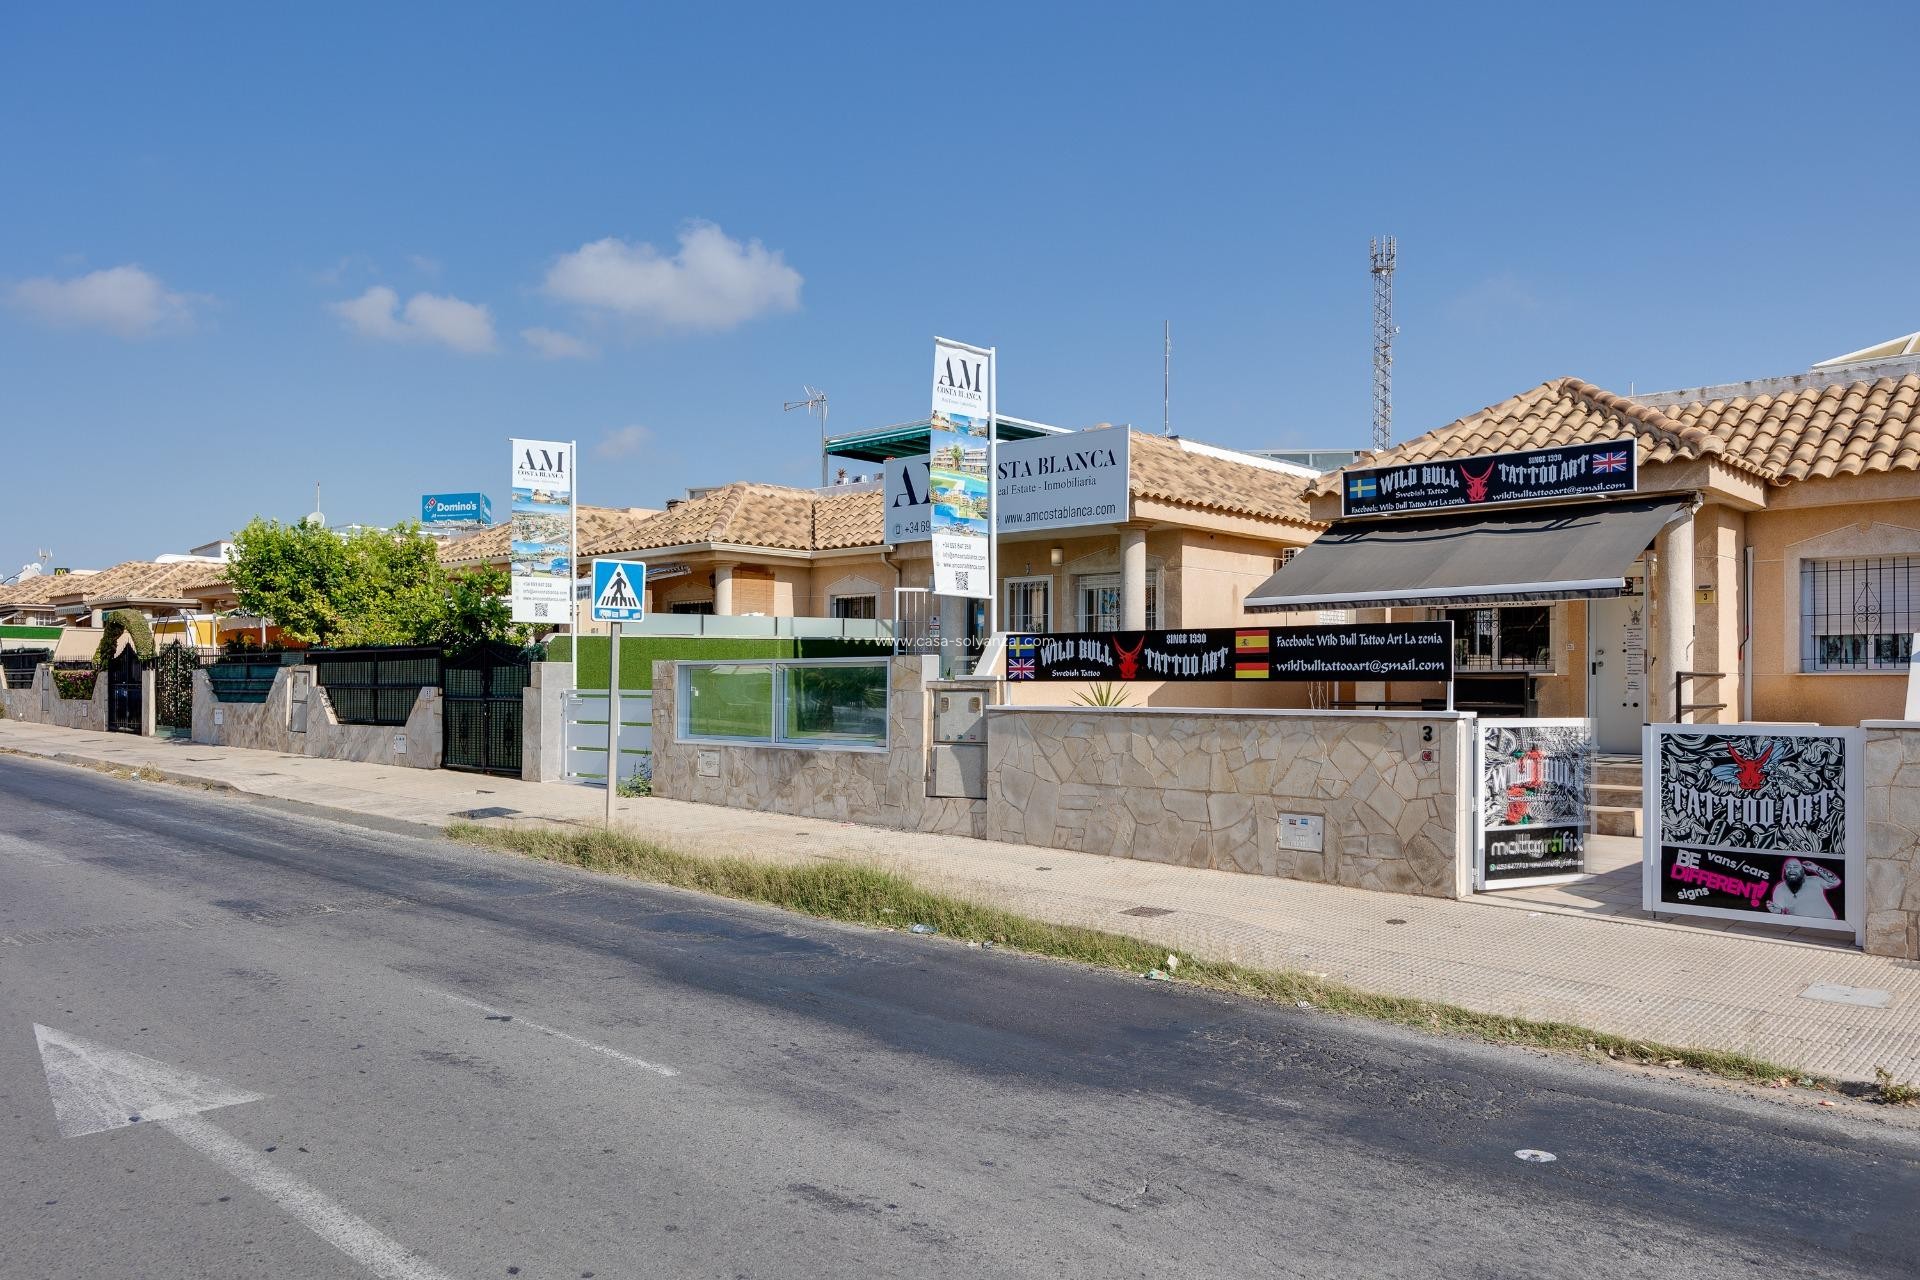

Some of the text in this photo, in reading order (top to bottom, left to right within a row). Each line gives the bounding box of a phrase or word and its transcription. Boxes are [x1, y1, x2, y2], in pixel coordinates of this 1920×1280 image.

[937, 356, 982, 392] AM
[936, 386, 982, 401] COSTA BLANCA
[519, 449, 564, 473] AM
[997, 449, 1117, 481] STA BLANCA
[1498, 454, 1590, 486] TATTOO ART
[539, 471, 564, 480] BLANCA
[892, 462, 931, 508] A
[1380, 465, 1460, 495] WILD BULL
[998, 485, 1009, 496] eal
[1011, 481, 1037, 495] Estate
[1044, 475, 1097, 491] Inmobiliaria
[1395, 488, 1425, 499] Swedish
[1493, 482, 1626, 501] wildbulltattooart@gmail.com
[437, 501, 477, 511] Domino's
[1004, 503, 1116, 524] www.amcostablanca.com
[1379, 502, 1395, 511] Wild
[1395, 502, 1408, 510] Bull
[1409, 500, 1427, 508] Tattoo
[1427, 499, 1438, 507] Art
[1439, 498, 1448, 506] La
[904, 520, 931, 534] +34 69
[1703, 592, 1708, 601] 3
[1166, 633, 1188, 645] SINCE
[1276, 632, 1443, 647] Facebook: Wild Bull Tattoo Art La zenia
[1040, 638, 1113, 668] WILD BULL
[1144, 646, 1229, 677] TATTOO ART
[1051, 669, 1100, 677] Swedish Tattoo
[1276, 658, 1445, 674] wildbulltattooart@gmail.com
[1422, 725, 1433, 742] 3
[1667, 782, 1836, 826] TATTOO ART
[1675, 849, 1702, 869] BE
[1707, 852, 1770, 880] vans/cars
[1670, 863, 1769, 908] DIFFERENT!
[1677, 886, 1710, 901] signs
